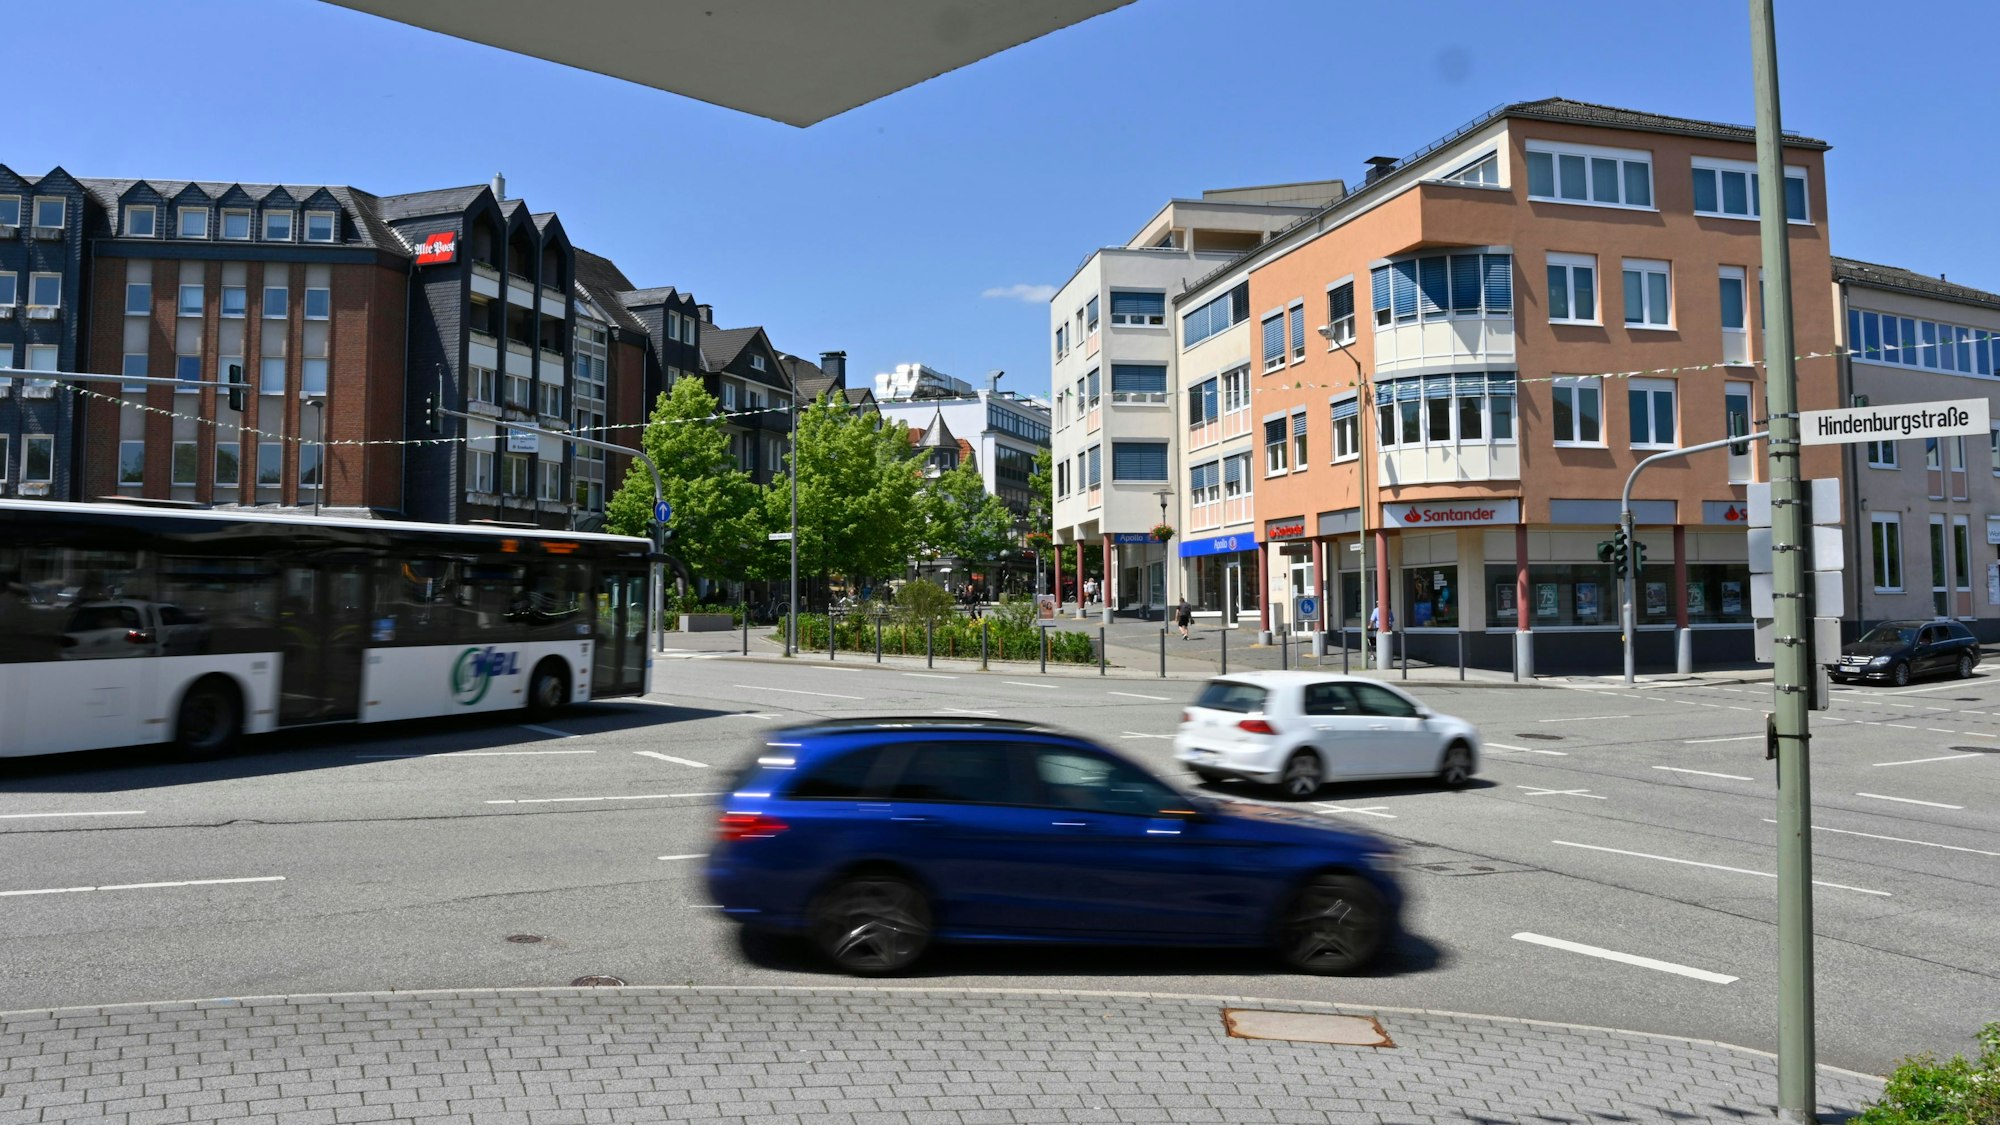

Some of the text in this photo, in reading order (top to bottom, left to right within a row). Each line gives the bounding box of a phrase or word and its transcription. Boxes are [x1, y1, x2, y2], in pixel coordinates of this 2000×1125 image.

[414, 240, 455, 256] Alte Post
[1818, 406, 1969, 436] Hindenburgstraße
[1423, 508, 1496, 521] Santander
[1120, 534, 1143, 542] Apollo
[1214, 538, 1227, 551] Apollo
